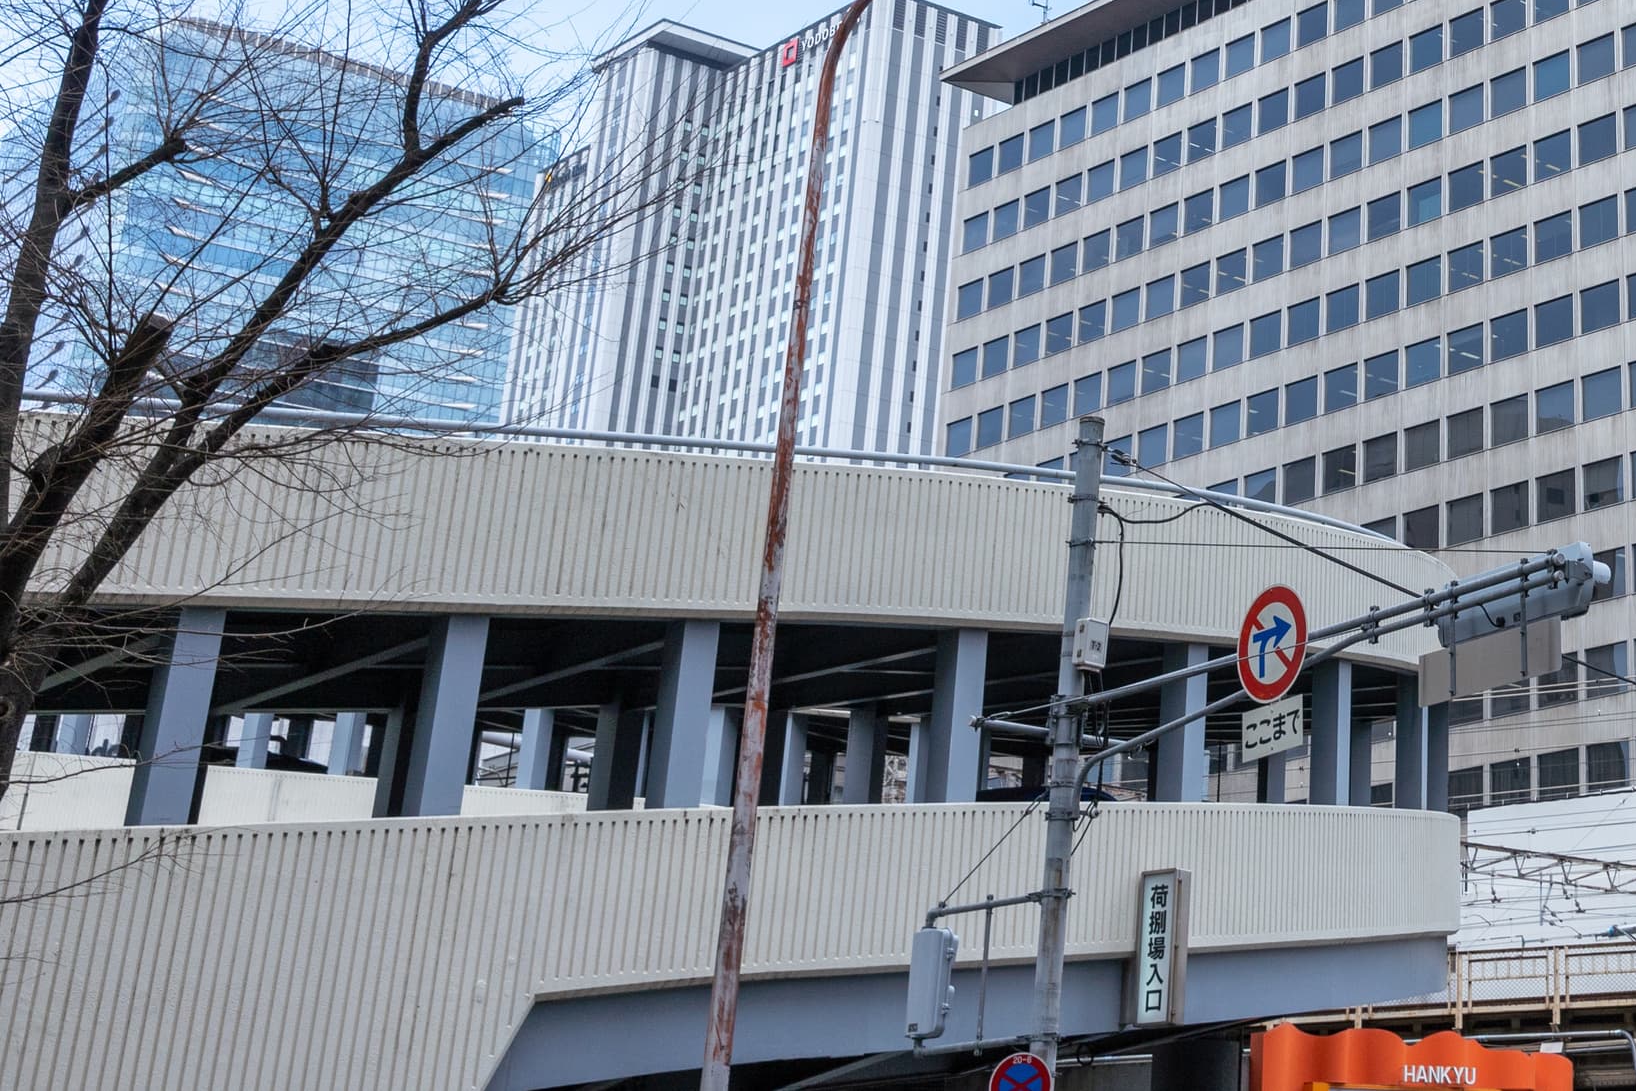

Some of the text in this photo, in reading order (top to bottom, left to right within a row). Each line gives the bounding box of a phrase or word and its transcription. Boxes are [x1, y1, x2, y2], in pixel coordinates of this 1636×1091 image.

[1244, 709, 1300, 749] ここまで
[1145, 884, 1169, 1013] 荷捌場入口
[1403, 1064, 1477, 1086] HANKYU
